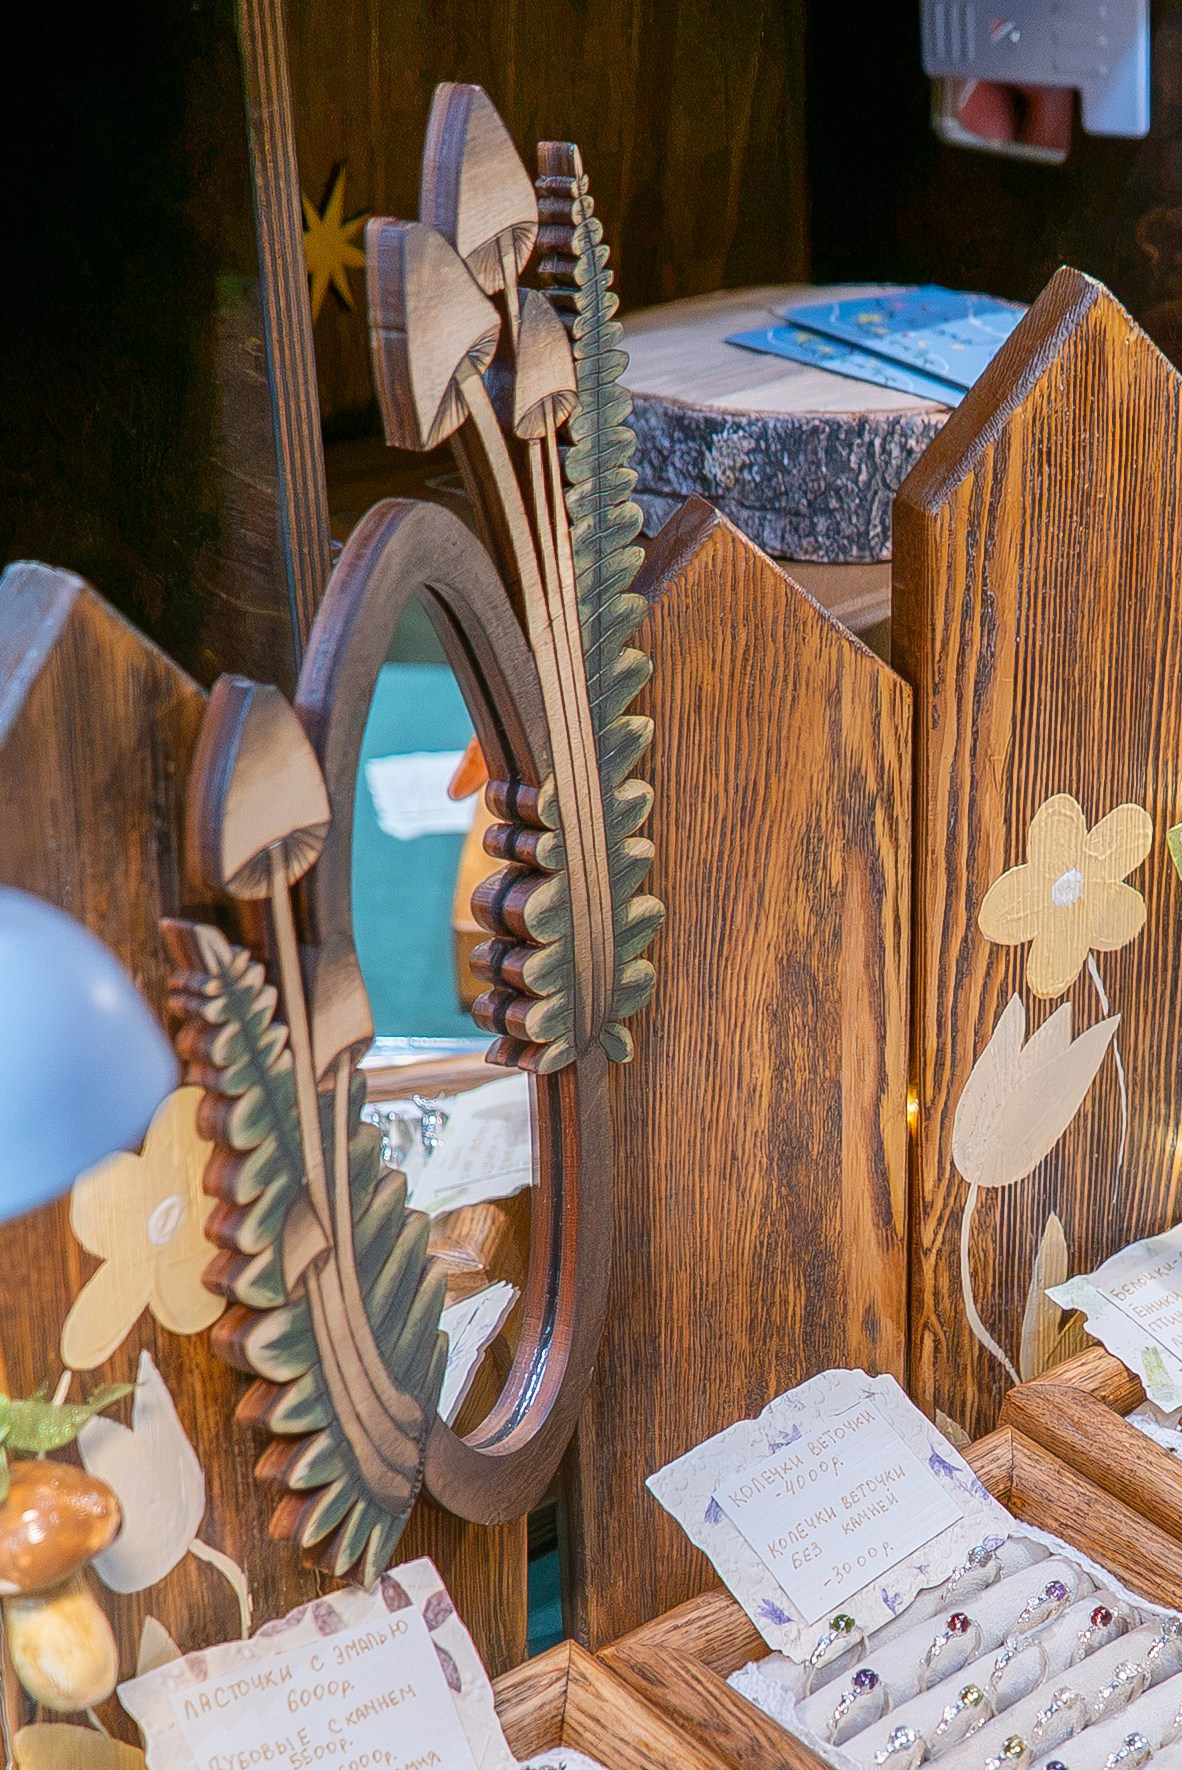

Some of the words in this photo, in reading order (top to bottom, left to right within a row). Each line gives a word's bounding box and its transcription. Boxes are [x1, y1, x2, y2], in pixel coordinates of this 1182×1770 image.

[728, 1456, 804, 1508] КОЛЕЧКИ
[807, 1410, 875, 1456] ВЕТОЧКИ
[768, 1507, 836, 1559] КОЛЕЧКИ
[841, 1465, 905, 1510] ВЕТОЧКИ
[792, 1542, 822, 1570] БЕЗ
[841, 1488, 898, 1534] КАМНЕЙ
[184, 1665, 293, 1719] ЛАСТОЧКИ
[333, 1619, 409, 1665] ЭМАЛЬЮ
